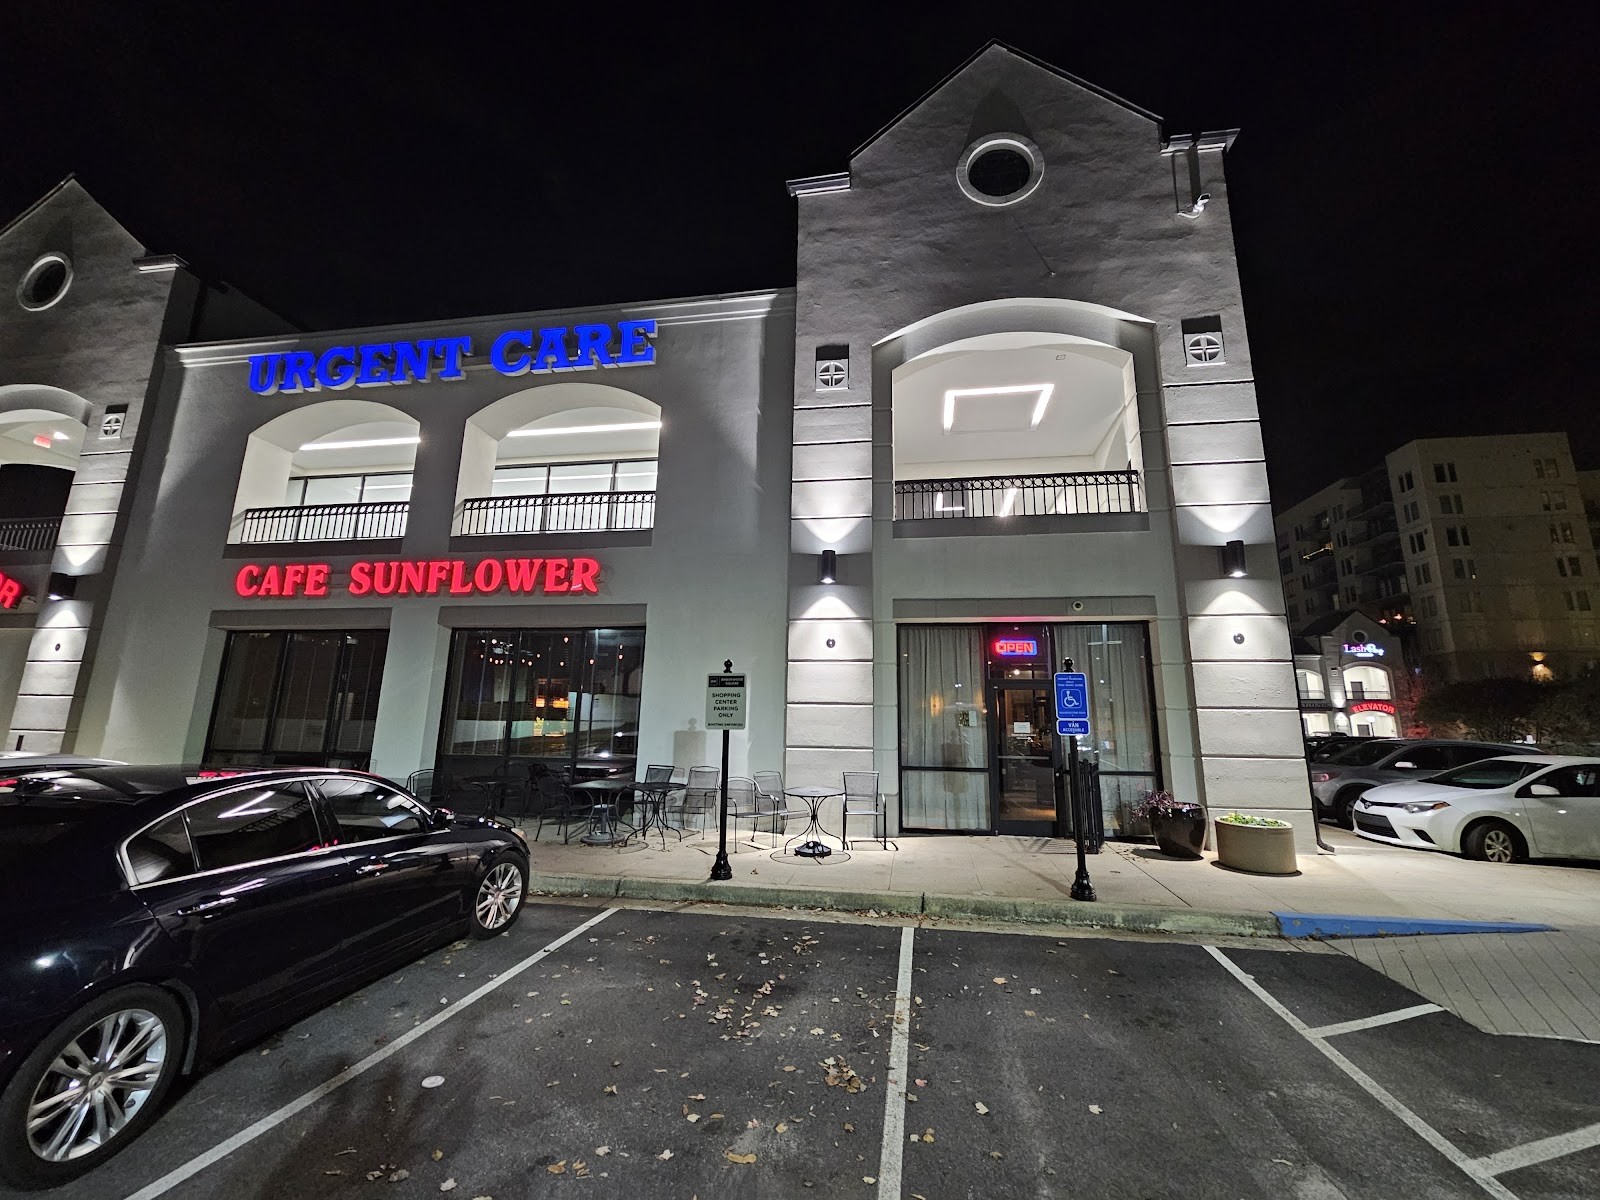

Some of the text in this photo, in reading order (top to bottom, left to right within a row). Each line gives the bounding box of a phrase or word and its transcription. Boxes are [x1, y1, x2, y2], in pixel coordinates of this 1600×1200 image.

[249, 320, 655, 392] URGENT CARE
[0, 572, 20, 608] R
[237, 559, 598, 595] CAFE SUNFLOWER
[995, 642, 1033, 652] OPEN
[1352, 703, 1395, 713] ELEVATOR
